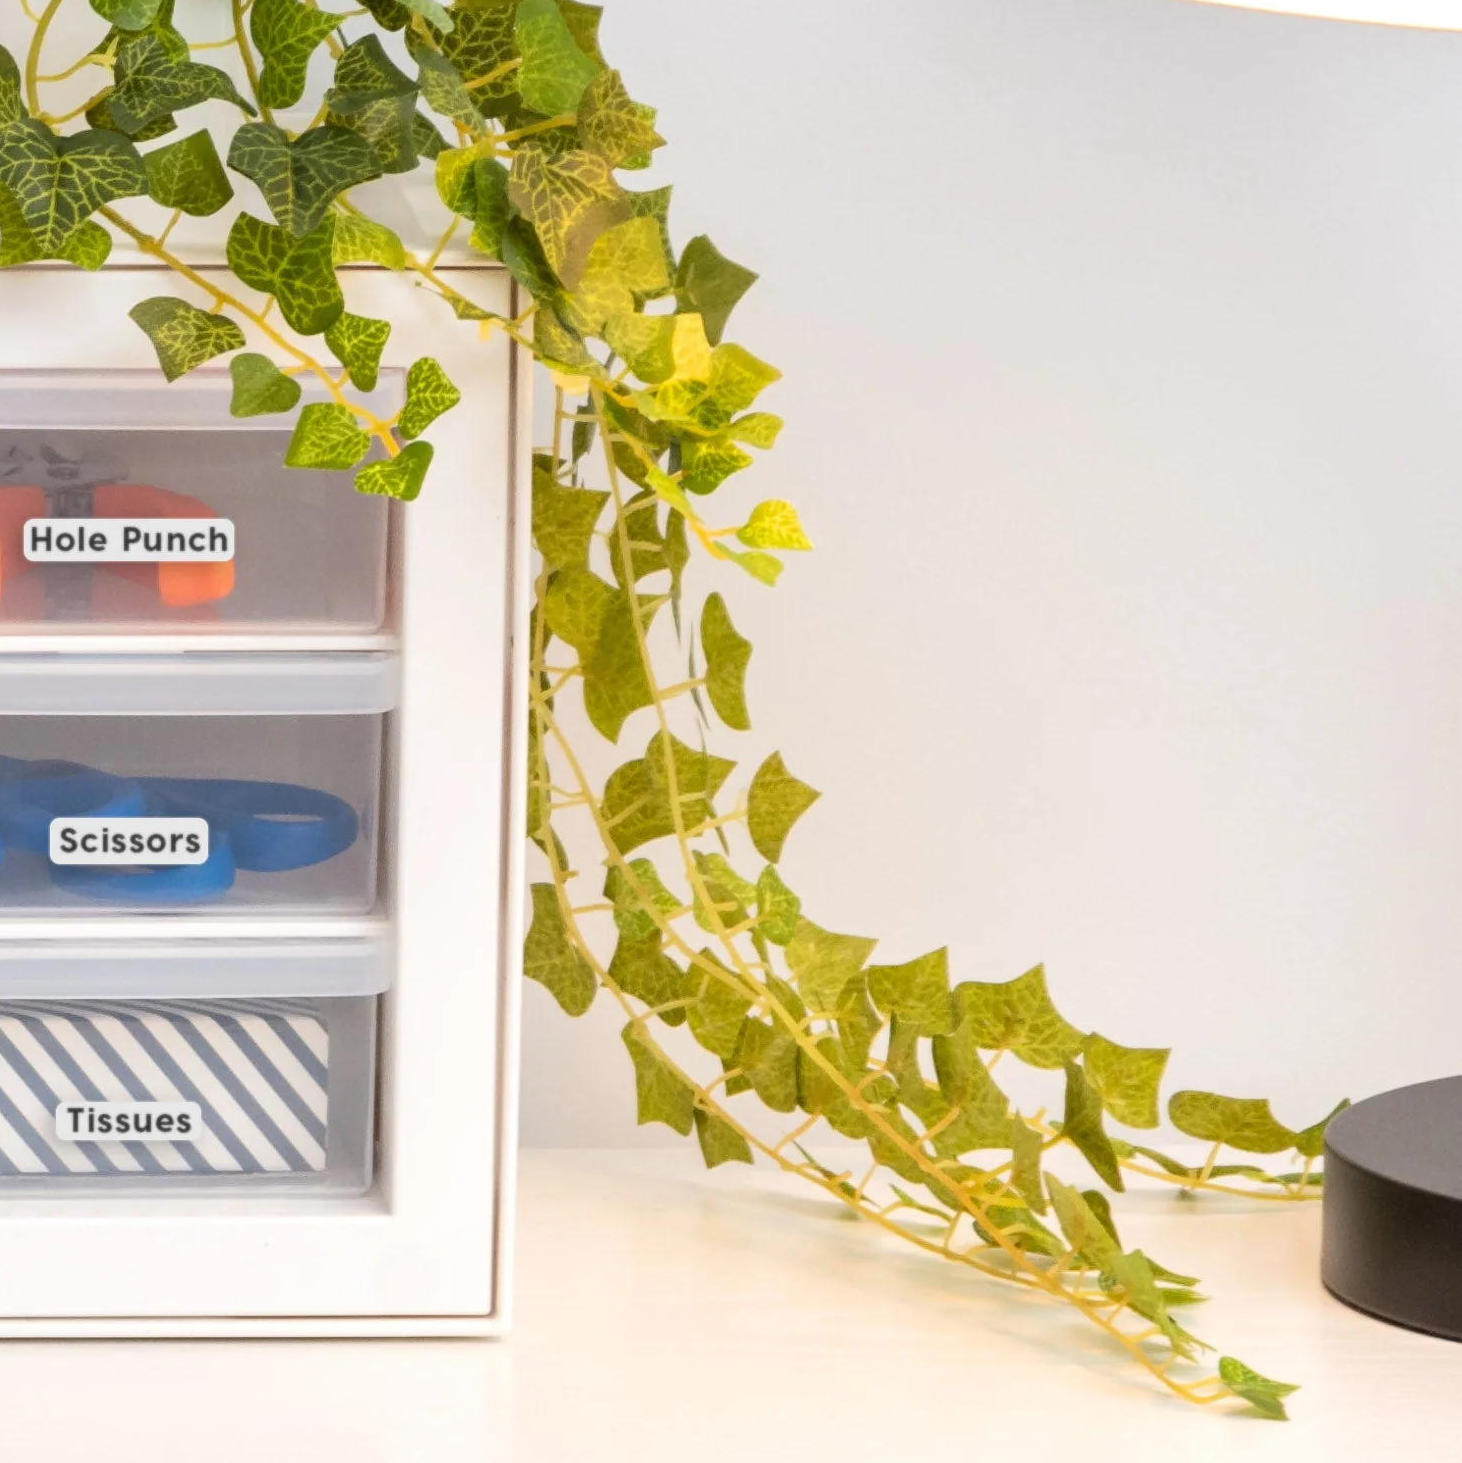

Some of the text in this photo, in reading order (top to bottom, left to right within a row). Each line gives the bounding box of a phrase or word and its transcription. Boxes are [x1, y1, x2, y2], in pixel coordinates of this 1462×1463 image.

[31, 526, 228, 552] Hole Punch
[60, 827, 201, 854] Scissors
[67, 1107, 192, 1134] Tissues
